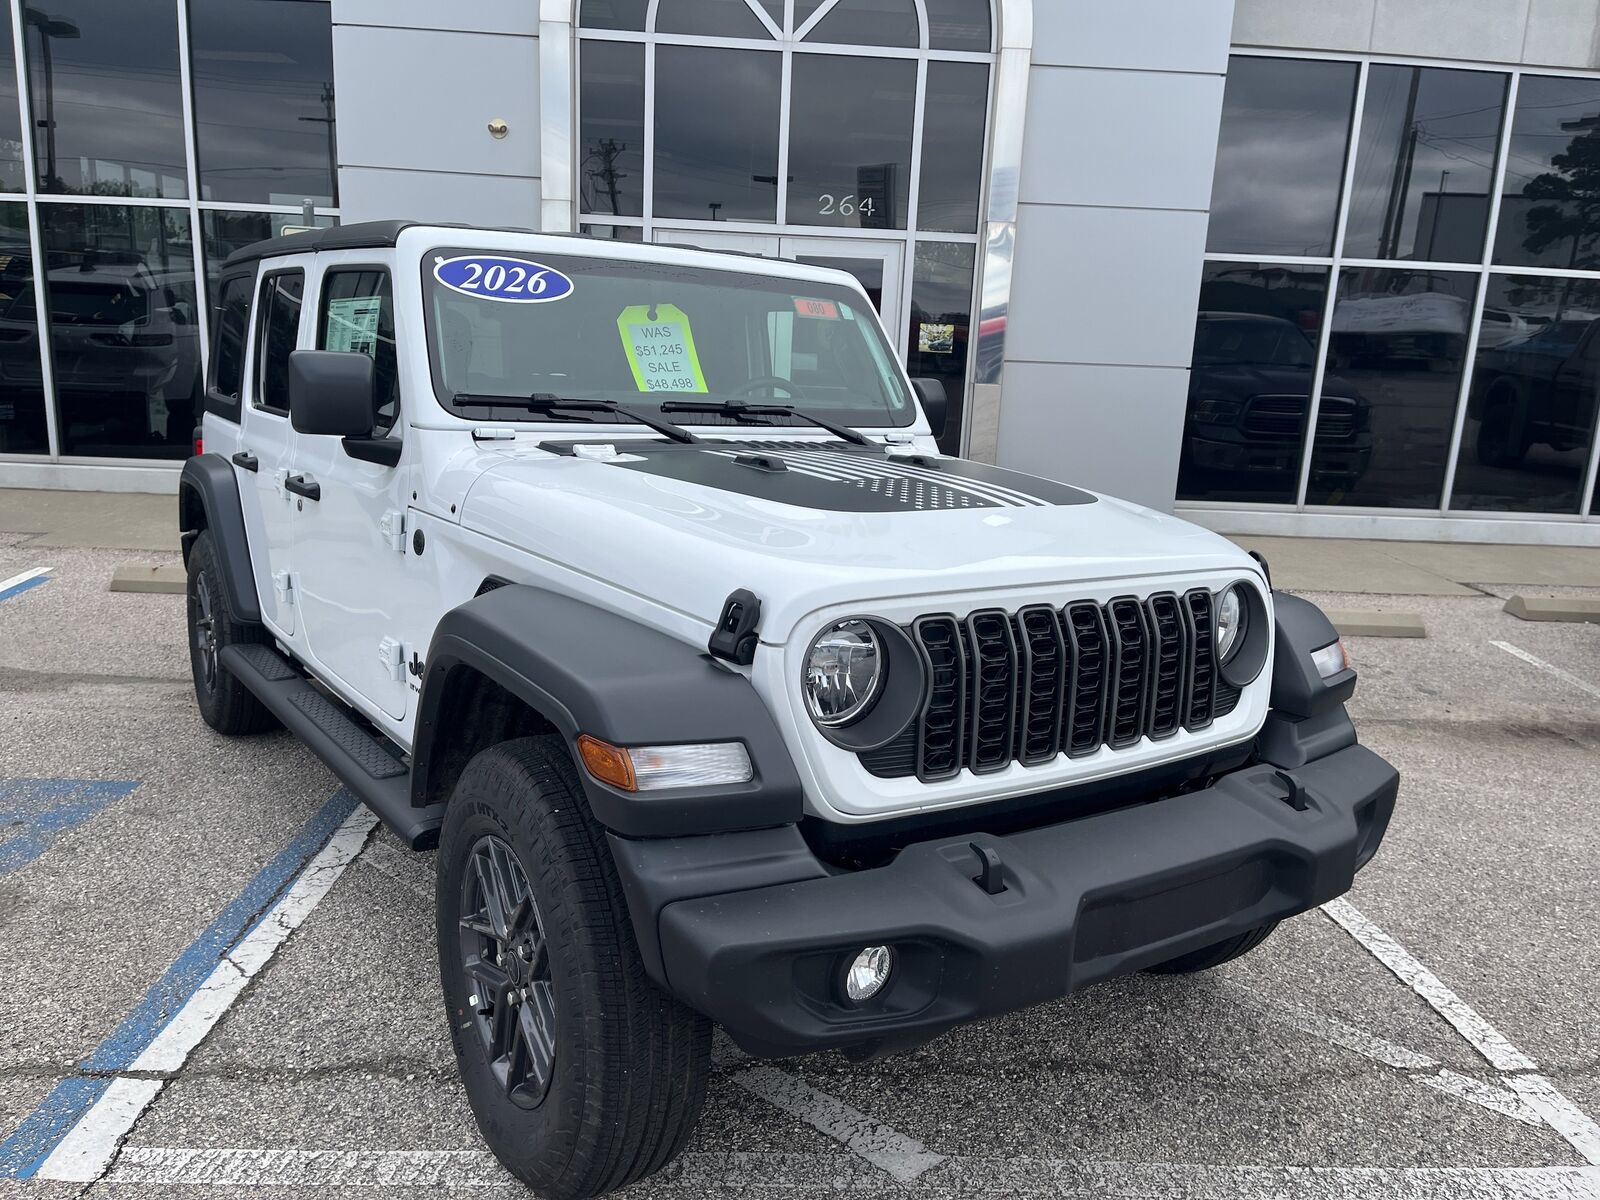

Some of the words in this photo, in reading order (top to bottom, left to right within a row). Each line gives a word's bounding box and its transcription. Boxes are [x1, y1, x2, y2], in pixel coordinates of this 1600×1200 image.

[819, 194, 875, 217] 264
[459, 263, 550, 294] 2026
[641, 326, 671, 338] WAS
[635, 344, 683, 357] $51,245
[648, 361, 681, 373] SALE
[646, 377, 693, 390] $48,498
